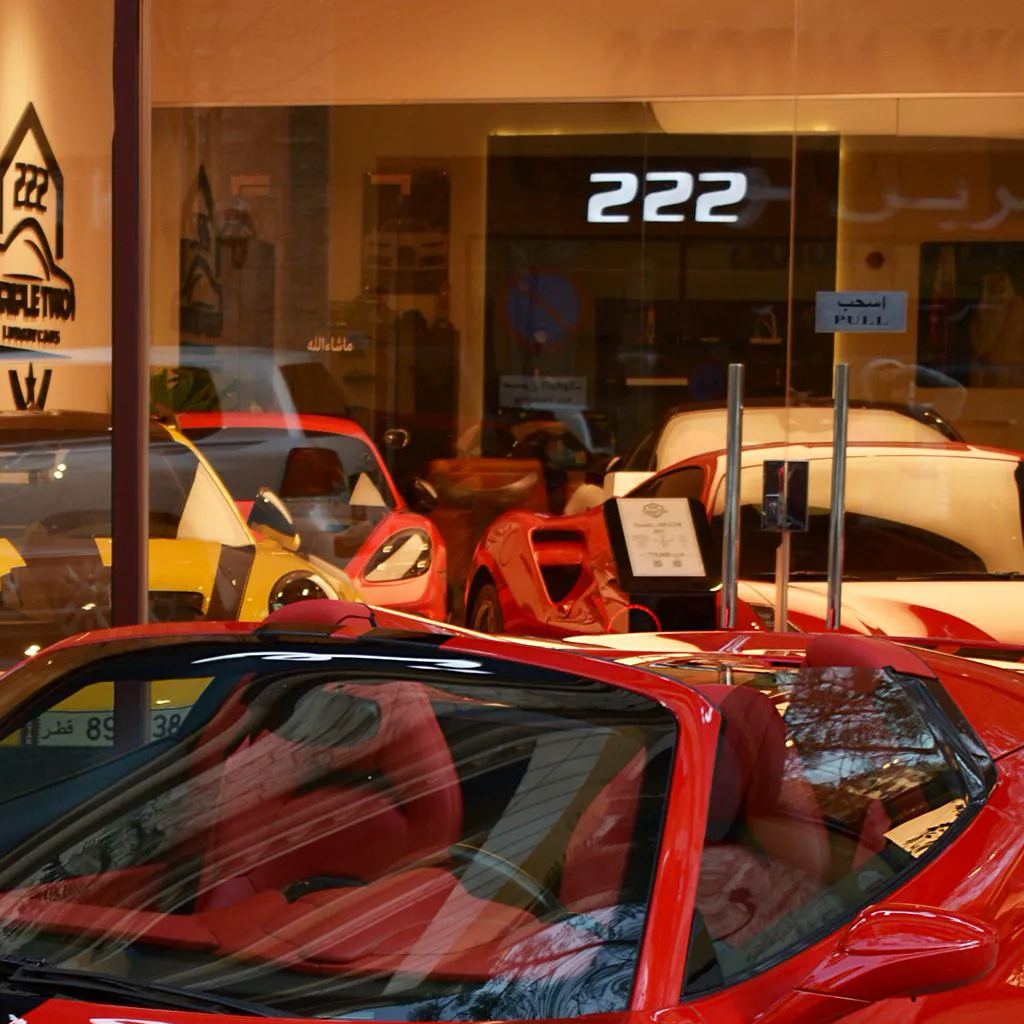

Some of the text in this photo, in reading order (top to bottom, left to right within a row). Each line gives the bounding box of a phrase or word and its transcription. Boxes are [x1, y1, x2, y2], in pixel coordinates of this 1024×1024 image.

[13, 162, 48, 212] 222
[588, 171, 747, 223] 222
[833, 314, 888, 326] PULL
[42, 719, 73, 739] قطر
